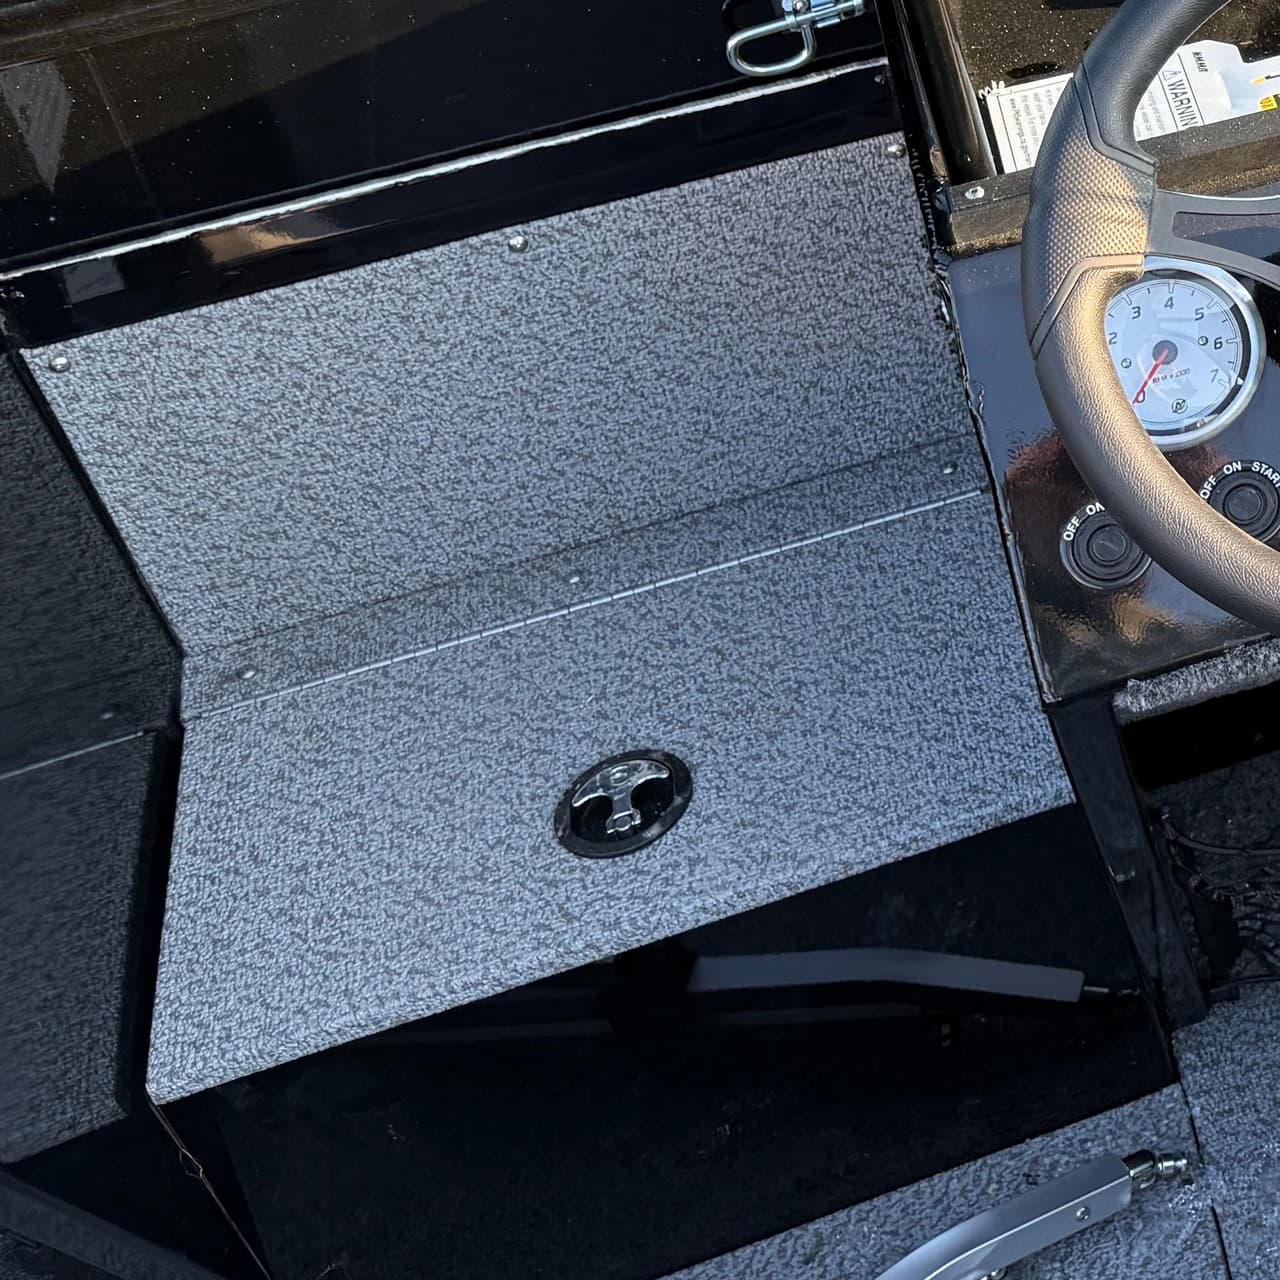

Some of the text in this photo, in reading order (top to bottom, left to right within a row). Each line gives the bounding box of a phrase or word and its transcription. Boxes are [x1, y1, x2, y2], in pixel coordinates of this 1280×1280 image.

[1164, 296, 1174, 310] 4
[1131, 306, 1141, 320] 3
[1194, 307, 1205, 321] 5
[1108, 332, 1118, 345] 2
[1213, 336, 1223, 350] 6
[1210, 368, 1219, 383] 7
[1200, 475, 1219, 499] OFF
[1223, 461, 1242, 475] ON
[1063, 516, 1082, 542] OFF
